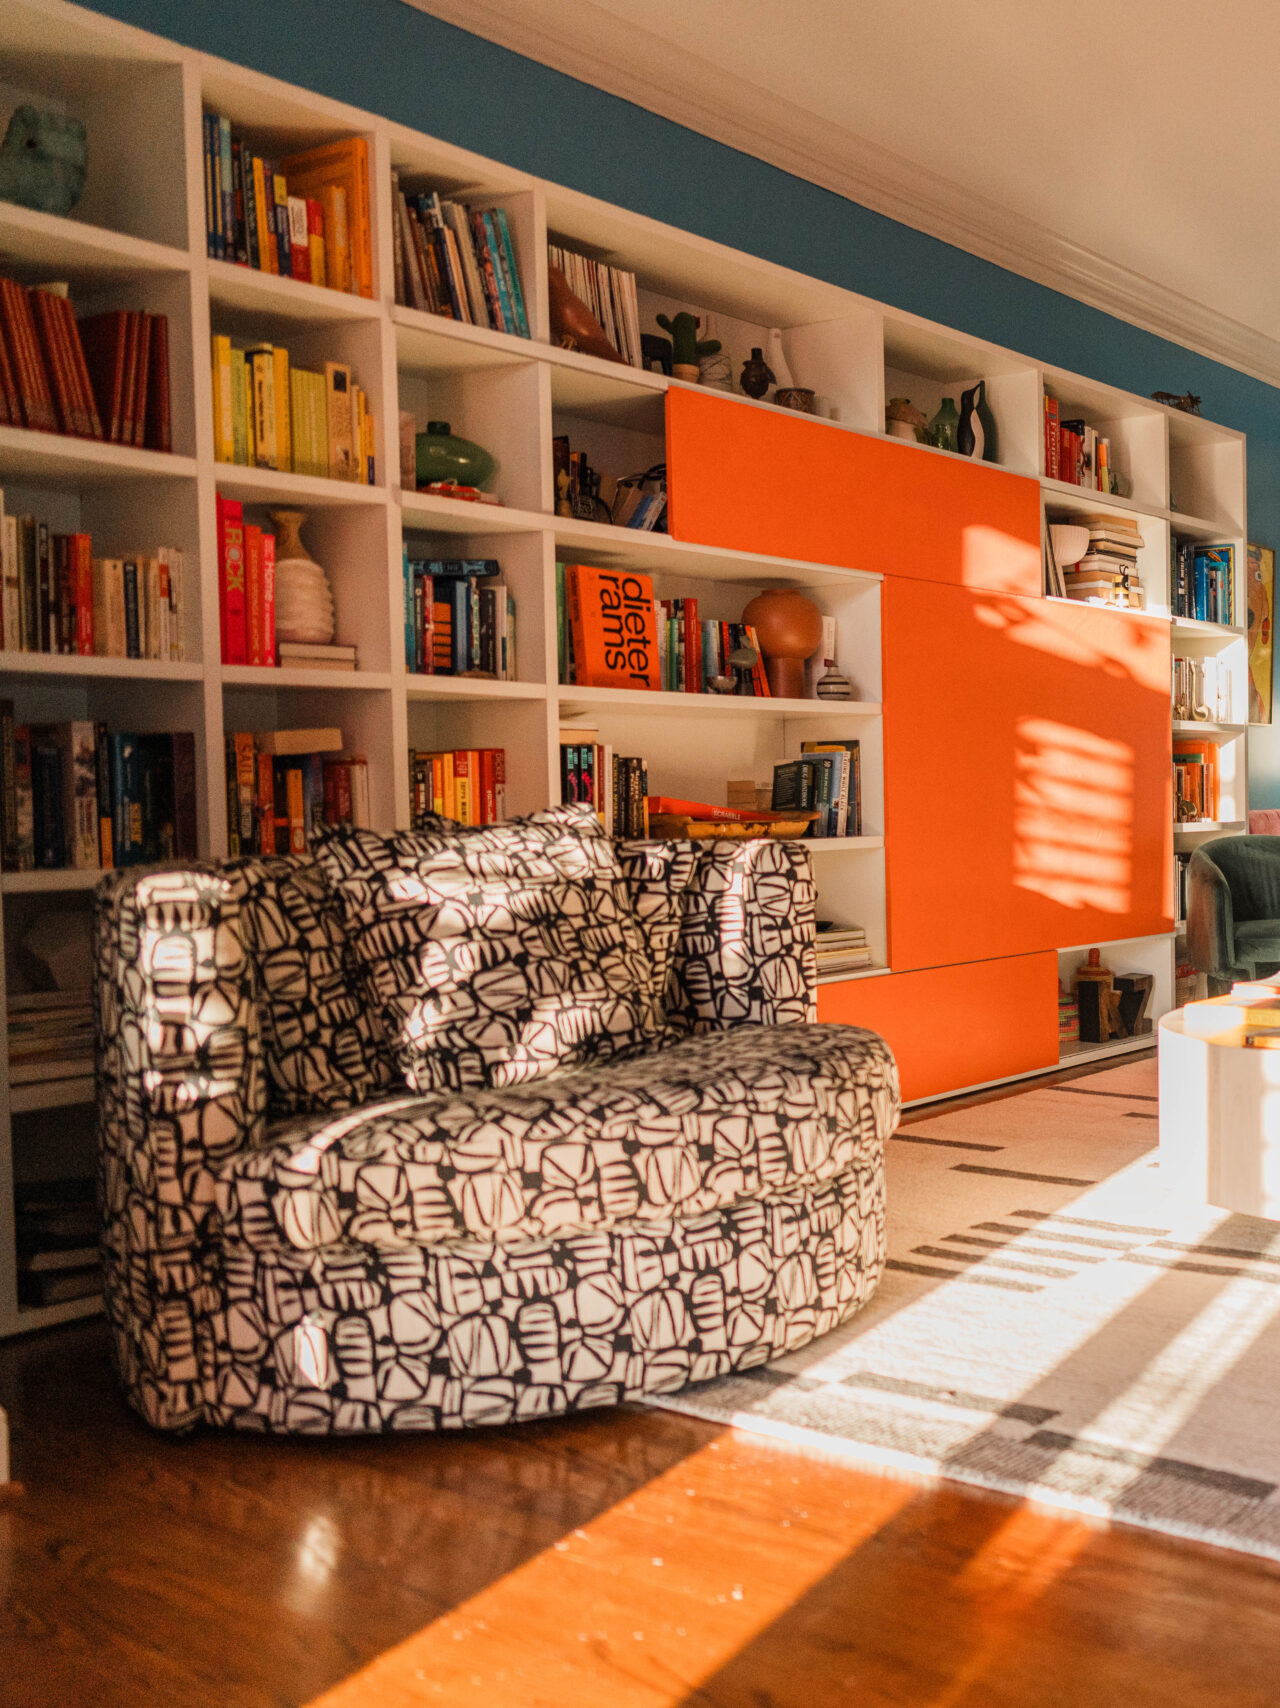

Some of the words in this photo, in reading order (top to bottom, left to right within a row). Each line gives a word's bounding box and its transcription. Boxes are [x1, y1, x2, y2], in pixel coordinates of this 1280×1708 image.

[264, 562, 275, 602] Home
[598, 574, 627, 671] rams
[621, 578, 651, 687] dieter
[801, 778, 809, 808] HANDBOOK
[713, 808, 741, 820] SCRABBLE
